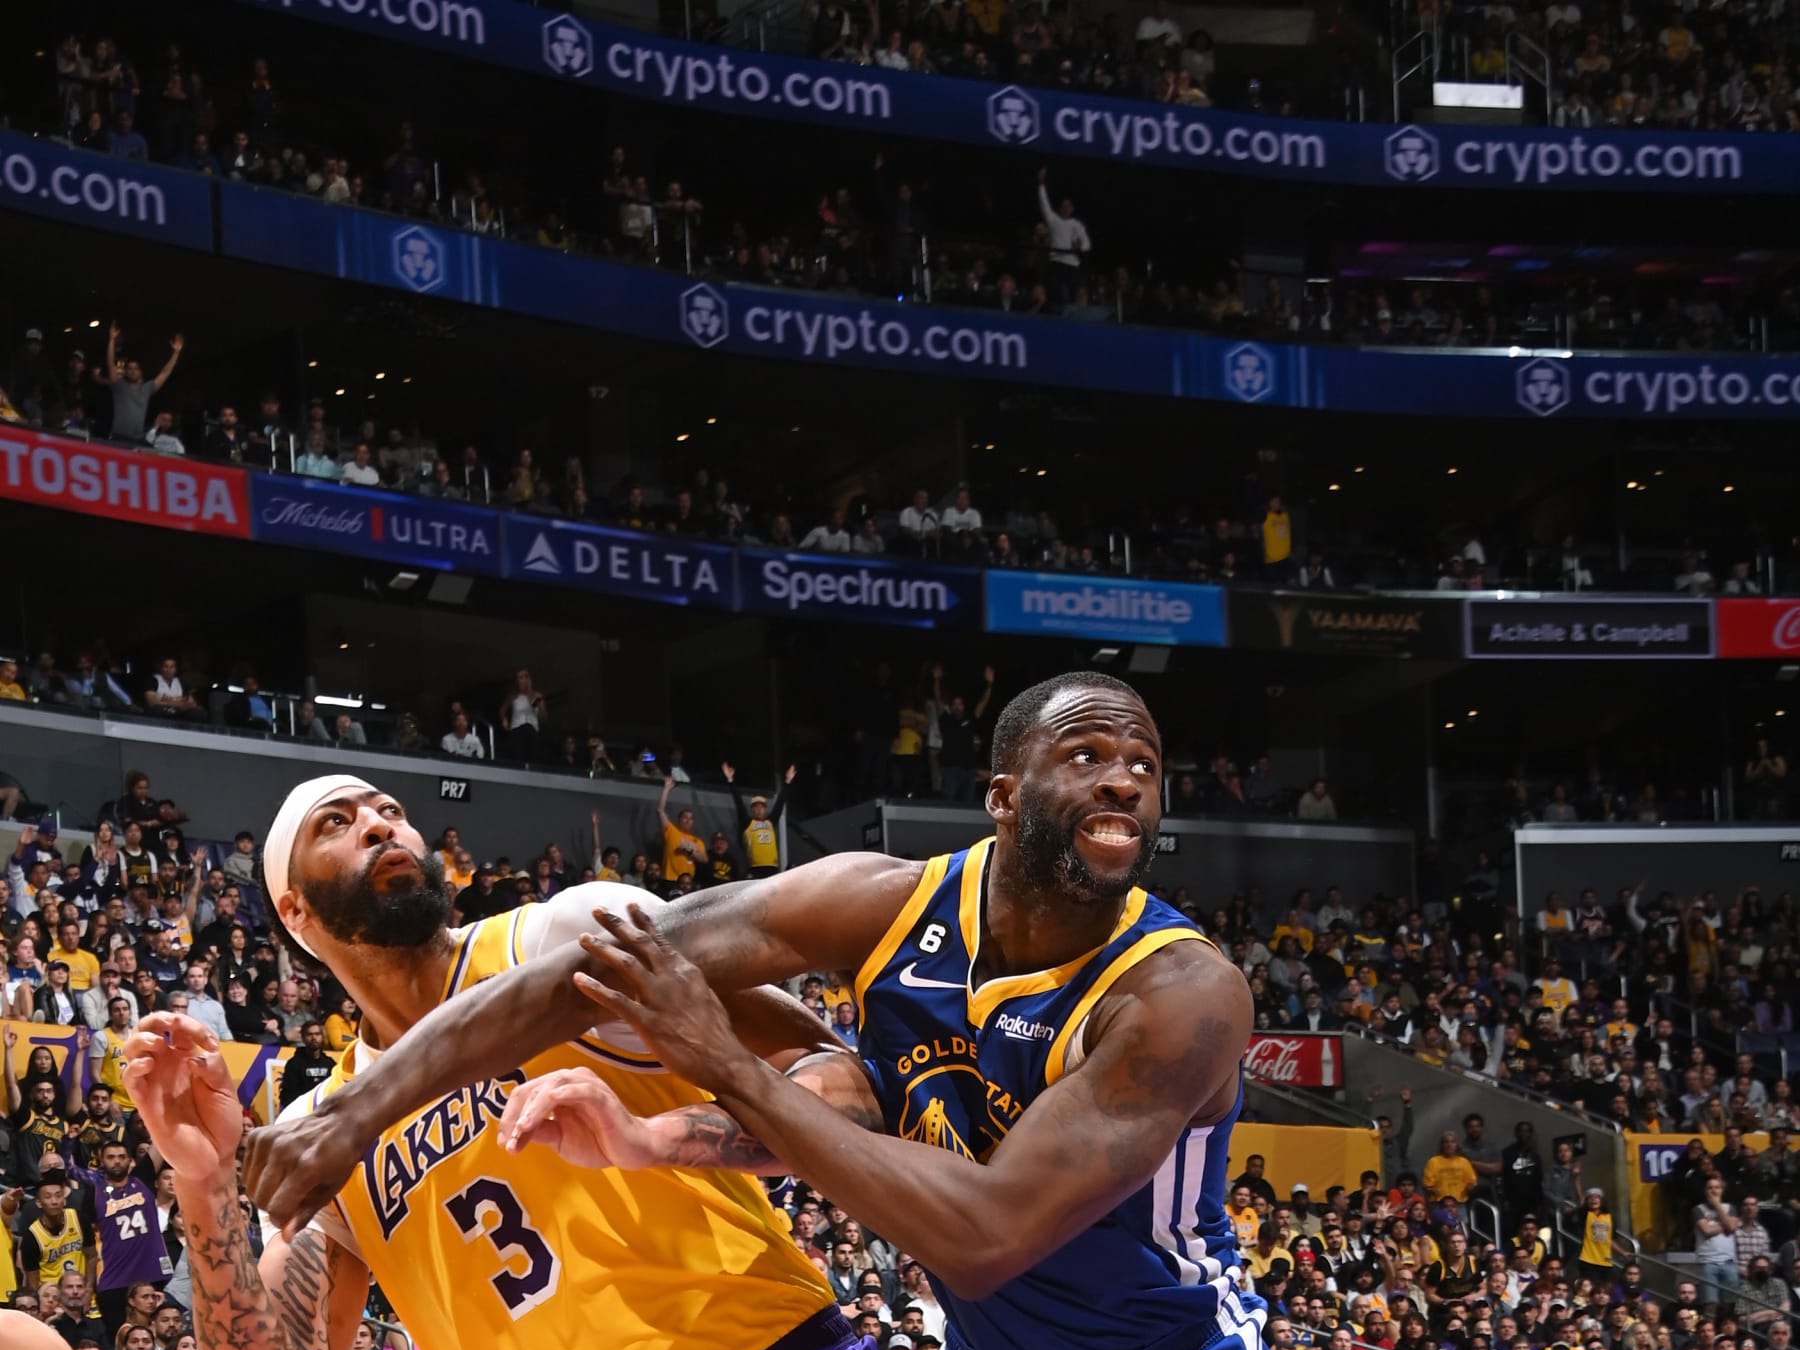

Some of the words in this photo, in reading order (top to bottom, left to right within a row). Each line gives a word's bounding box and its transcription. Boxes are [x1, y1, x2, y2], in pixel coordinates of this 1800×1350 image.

[606, 42, 890, 118] crypto.com
[1053, 105, 1326, 168] crypto.com
[1453, 136, 1742, 182] crypto.com
[0, 154, 165, 224] o.com
[743, 307, 1027, 368] crypto.com
[0, 441, 238, 524] TOSHIBA
[262, 498, 364, 534] Michelob
[391, 515, 490, 555] ULTRA
[573, 540, 719, 594] DELTA
[762, 559, 948, 611] Spectrum
[1021, 586, 1193, 623] mobilitie
[1570, 624, 1587, 641] &
[1591, 623, 1689, 648] Campbell
[440, 780, 468, 799] PR7
[919, 923, 946, 953] 6
[994, 1013, 1055, 1041] Rakuten
[115, 1209, 148, 1240] 24
[442, 1175, 562, 1321] 3
